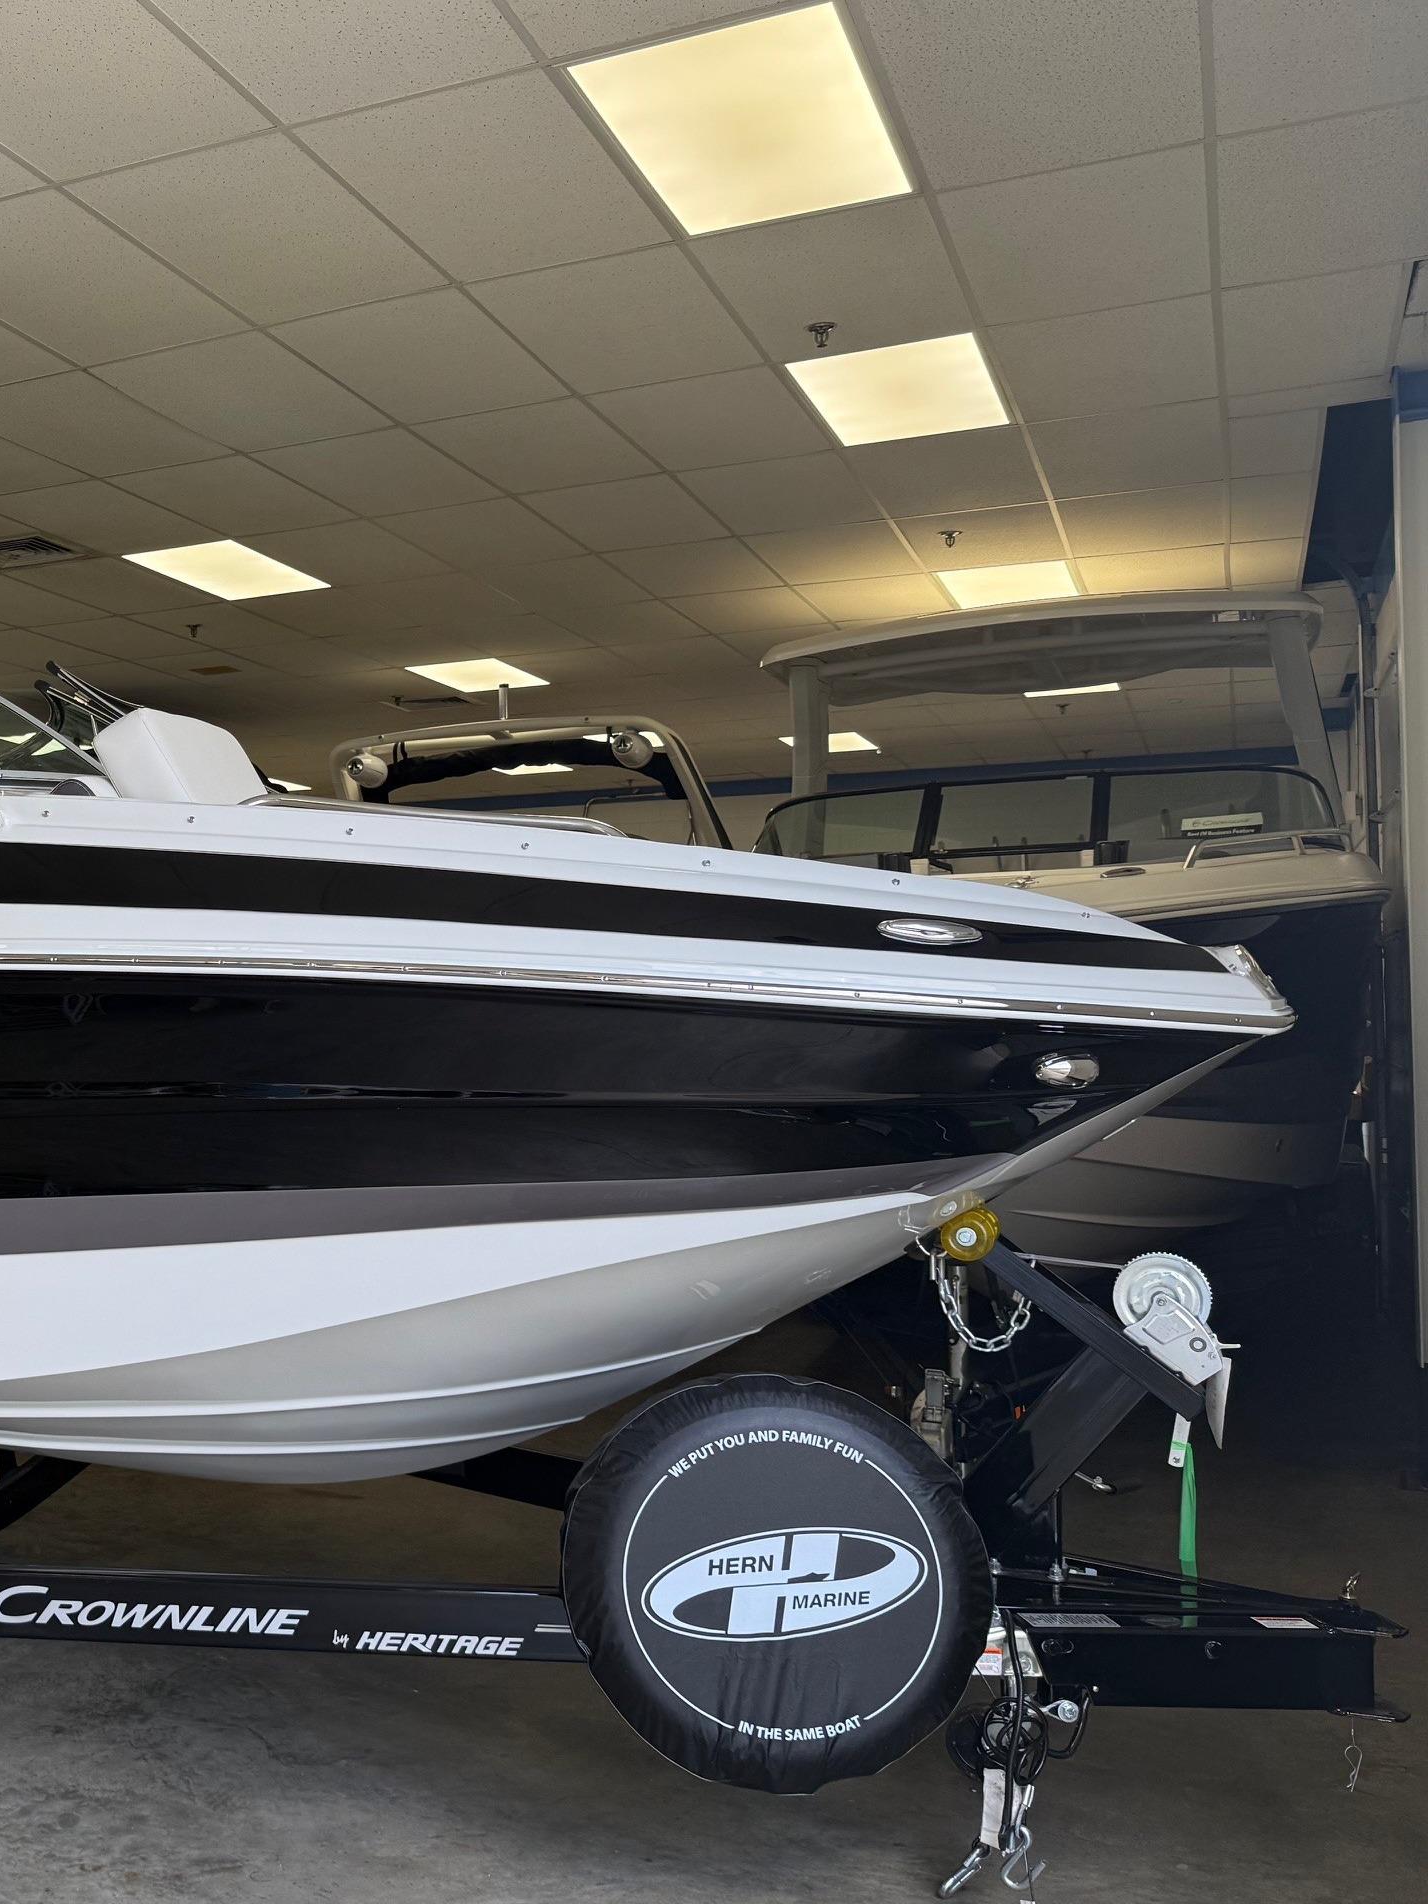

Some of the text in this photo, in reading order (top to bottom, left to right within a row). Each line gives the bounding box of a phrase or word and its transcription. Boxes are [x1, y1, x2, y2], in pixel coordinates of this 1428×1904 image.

[668, 1429, 864, 1478] WE PUT YOU AND FAMILY FUN
[708, 1555, 774, 1576] HERN
[792, 1591, 870, 1610] MARINE
[332, 1629, 524, 1656] by HERITAGE
[738, 1714, 861, 1741] IN THE SAME BOAT
